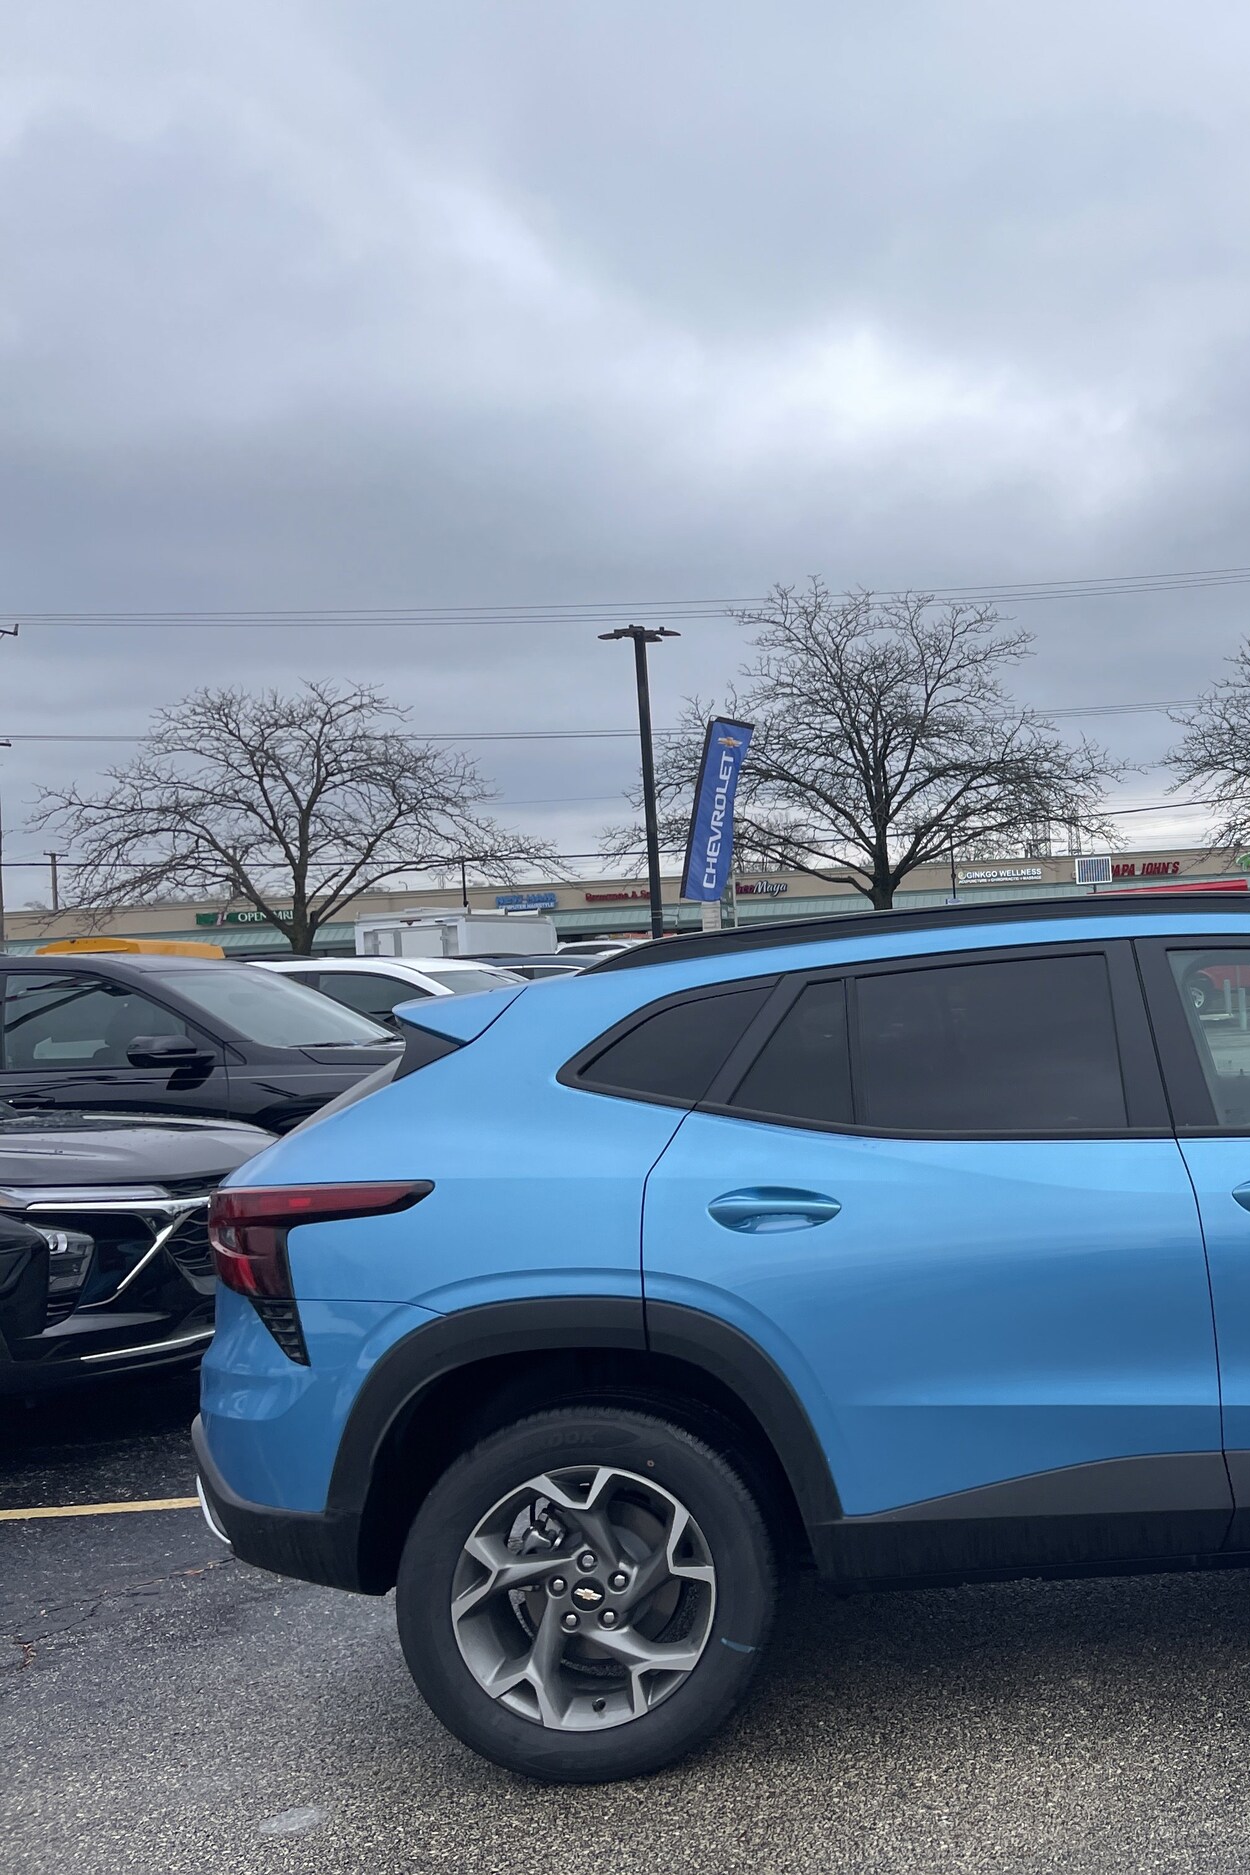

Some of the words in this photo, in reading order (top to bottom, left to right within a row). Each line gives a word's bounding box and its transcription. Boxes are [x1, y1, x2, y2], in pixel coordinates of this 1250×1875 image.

[703, 751, 735, 889] CHEVROLET
[966, 870, 998, 879] GINKGO
[999, 868, 1042, 877] WELLNESS
[1111, 863, 1136, 877] APA
[1141, 861, 1180, 875] JOHN'S
